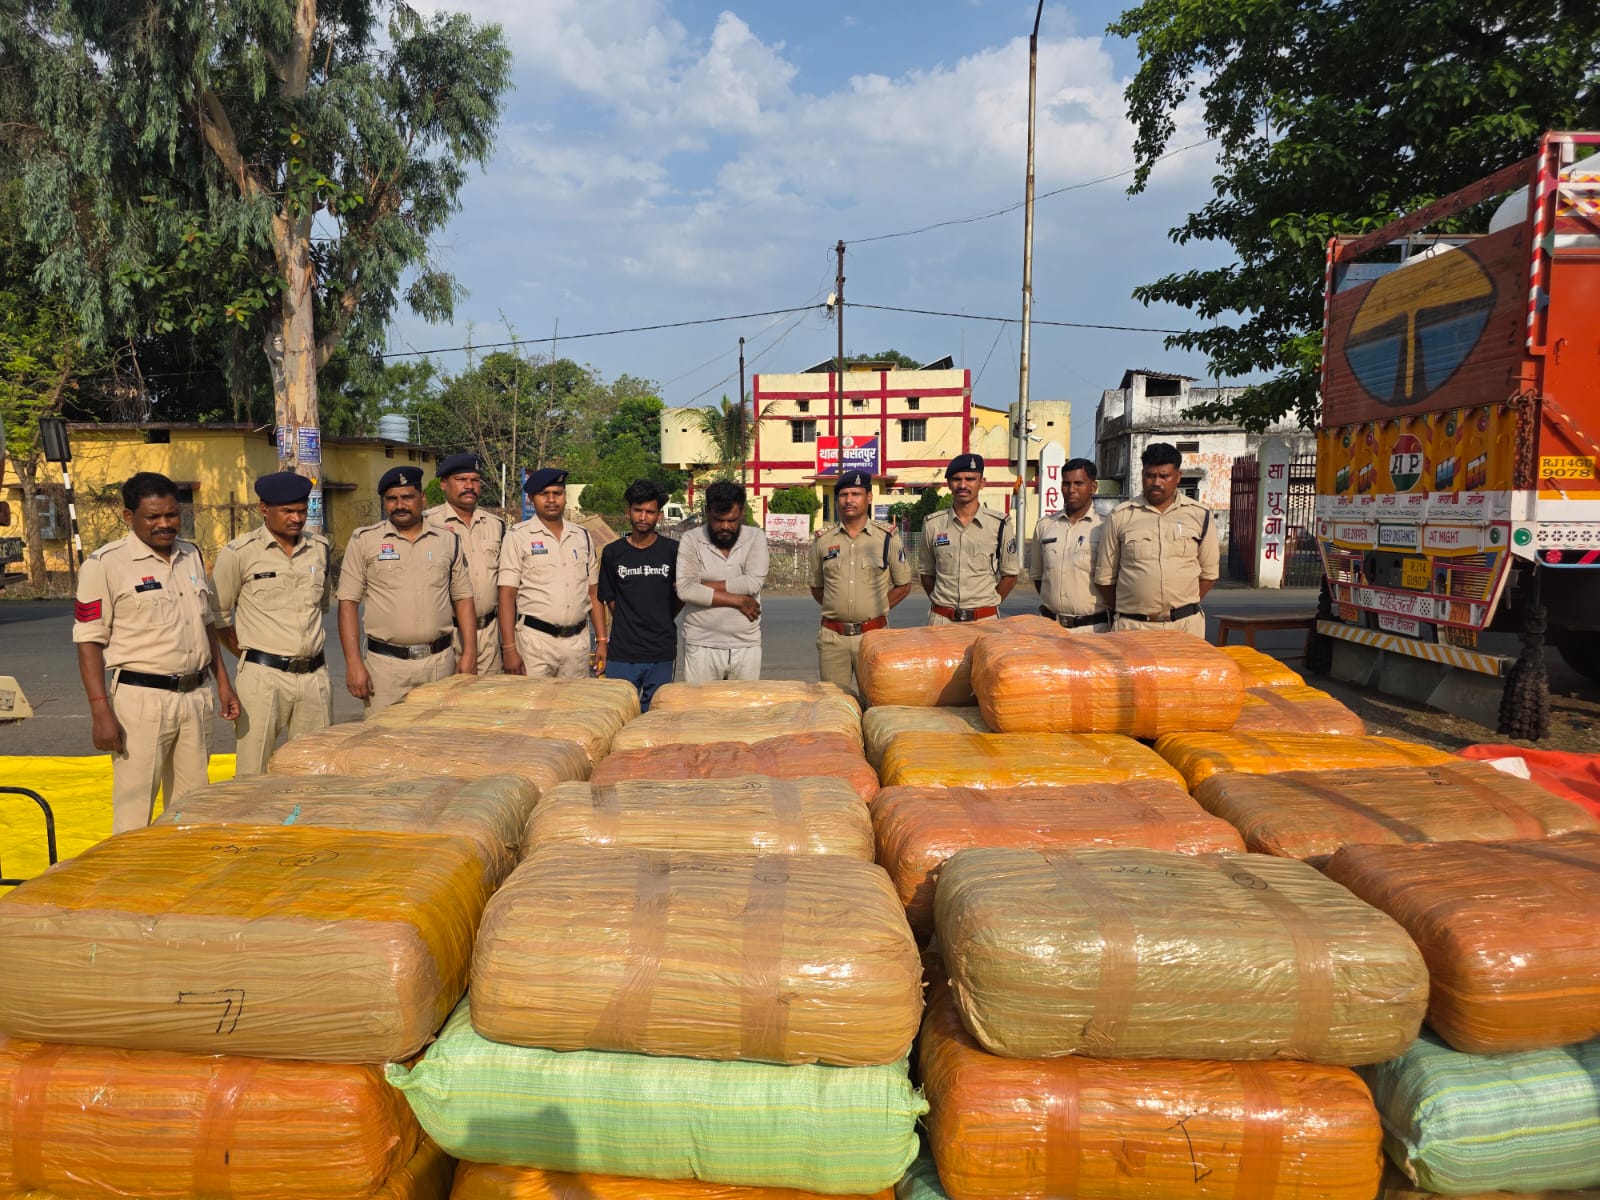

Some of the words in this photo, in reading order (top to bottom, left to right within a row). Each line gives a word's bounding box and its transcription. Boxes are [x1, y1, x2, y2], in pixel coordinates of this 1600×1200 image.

[842, 445, 877, 463] बसंतपुर
[1543, 468, 1591, 477] 9078
[1429, 531, 1438, 542] AT
[1439, 531, 1460, 544] NIGHT
